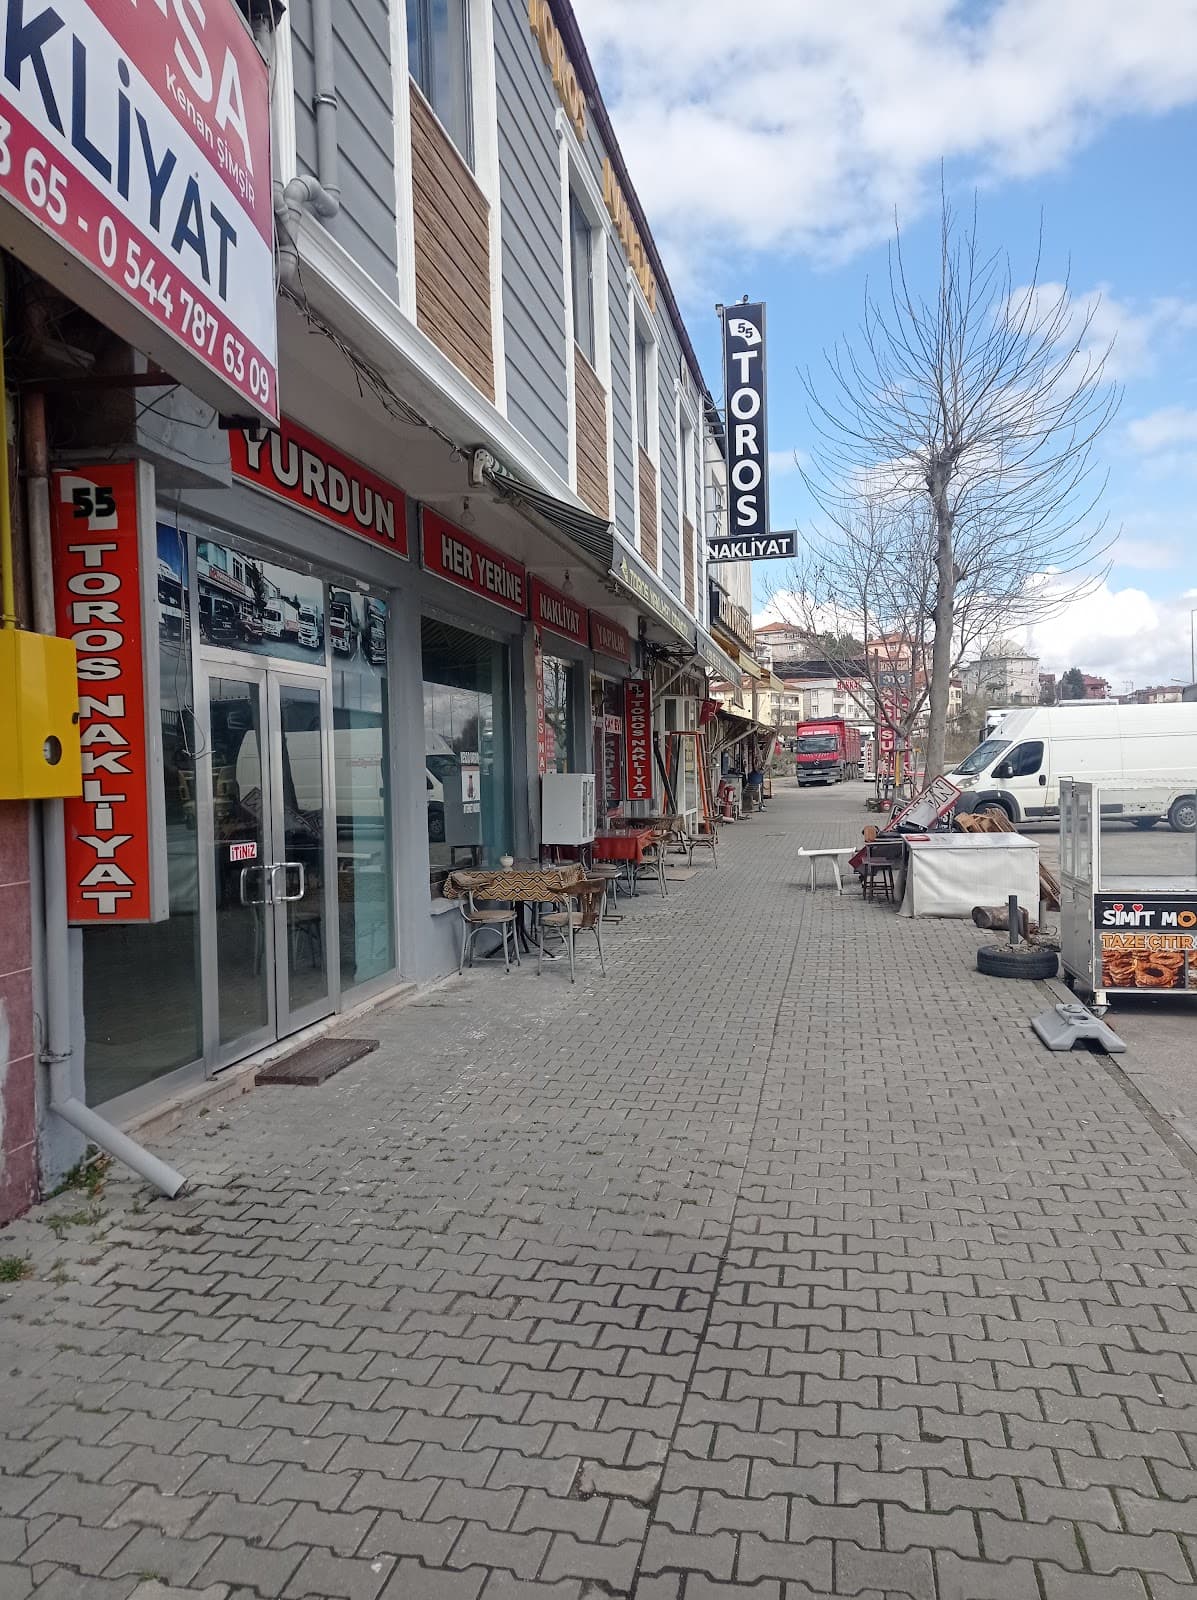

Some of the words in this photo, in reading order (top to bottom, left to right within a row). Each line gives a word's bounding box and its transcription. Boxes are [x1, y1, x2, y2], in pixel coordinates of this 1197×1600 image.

[130, 0, 254, 176] SA
[165, 64, 214, 149] Kenan
[216, 137, 256, 209] ŞİMŞİR
[24, 147, 68, 226] 65
[98, 215, 117, 267] 0
[124, 237, 174, 319] 544
[179, 287, 219, 356] 787
[222, 331, 245, 383] 63
[248, 359, 271, 404] 09
[737, 322, 754, 339] 55
[241, 428, 395, 539] YURDUN
[730, 350, 762, 526] TOROS
[72, 487, 116, 518] 55
[441, 533, 474, 581] HER
[476, 553, 522, 604] YERİNE
[706, 537, 791, 560] NAKLİYAT
[67, 543, 124, 680] TOROS
[540, 593, 581, 635] NAKLİYAT
[630, 700, 646, 737] TOROS
[78, 694, 136, 914] NAKLİYAT
[1102, 934, 1145, 948] TAZE
[1148, 934, 1193, 950] ÇITIR
